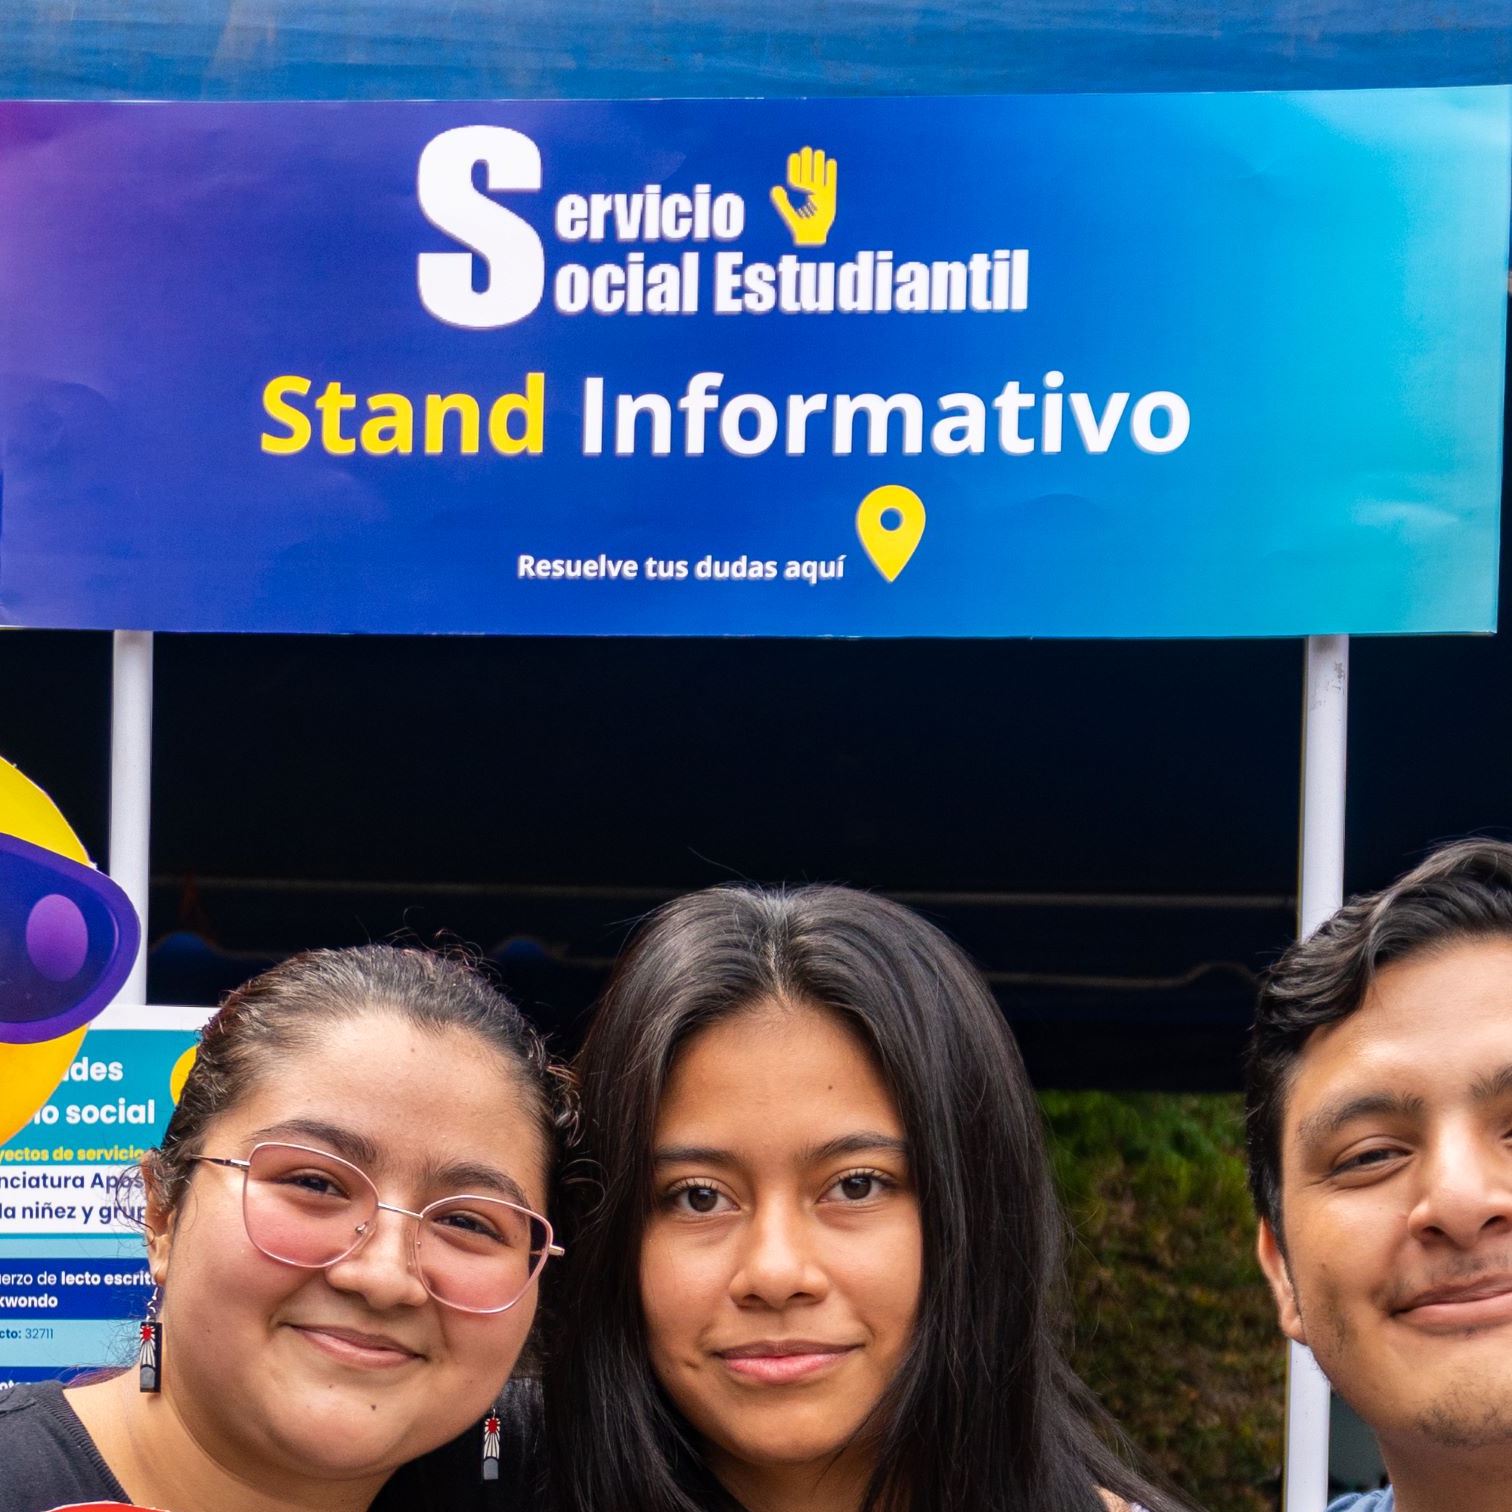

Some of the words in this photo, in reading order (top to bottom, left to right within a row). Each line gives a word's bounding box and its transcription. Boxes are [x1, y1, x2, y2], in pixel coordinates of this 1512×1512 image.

[714, 248, 1029, 312] Estudiantil
[261, 372, 545, 456] Stand
[583, 369, 1190, 456] Informativo
[518, 554, 638, 578] Resuelve
[646, 556, 689, 578] tus
[695, 554, 778, 579] dudas
[784, 554, 846, 585] aquí
[66, 1097, 155, 1124] social
[52, 1146, 74, 1161] de
[21, 1201, 76, 1219] niñez
[81, 1206, 94, 1224] y
[37, 1271, 57, 1285] de
[61, 1271, 101, 1286] lecto
[25, 1327, 54, 1340] 32711
